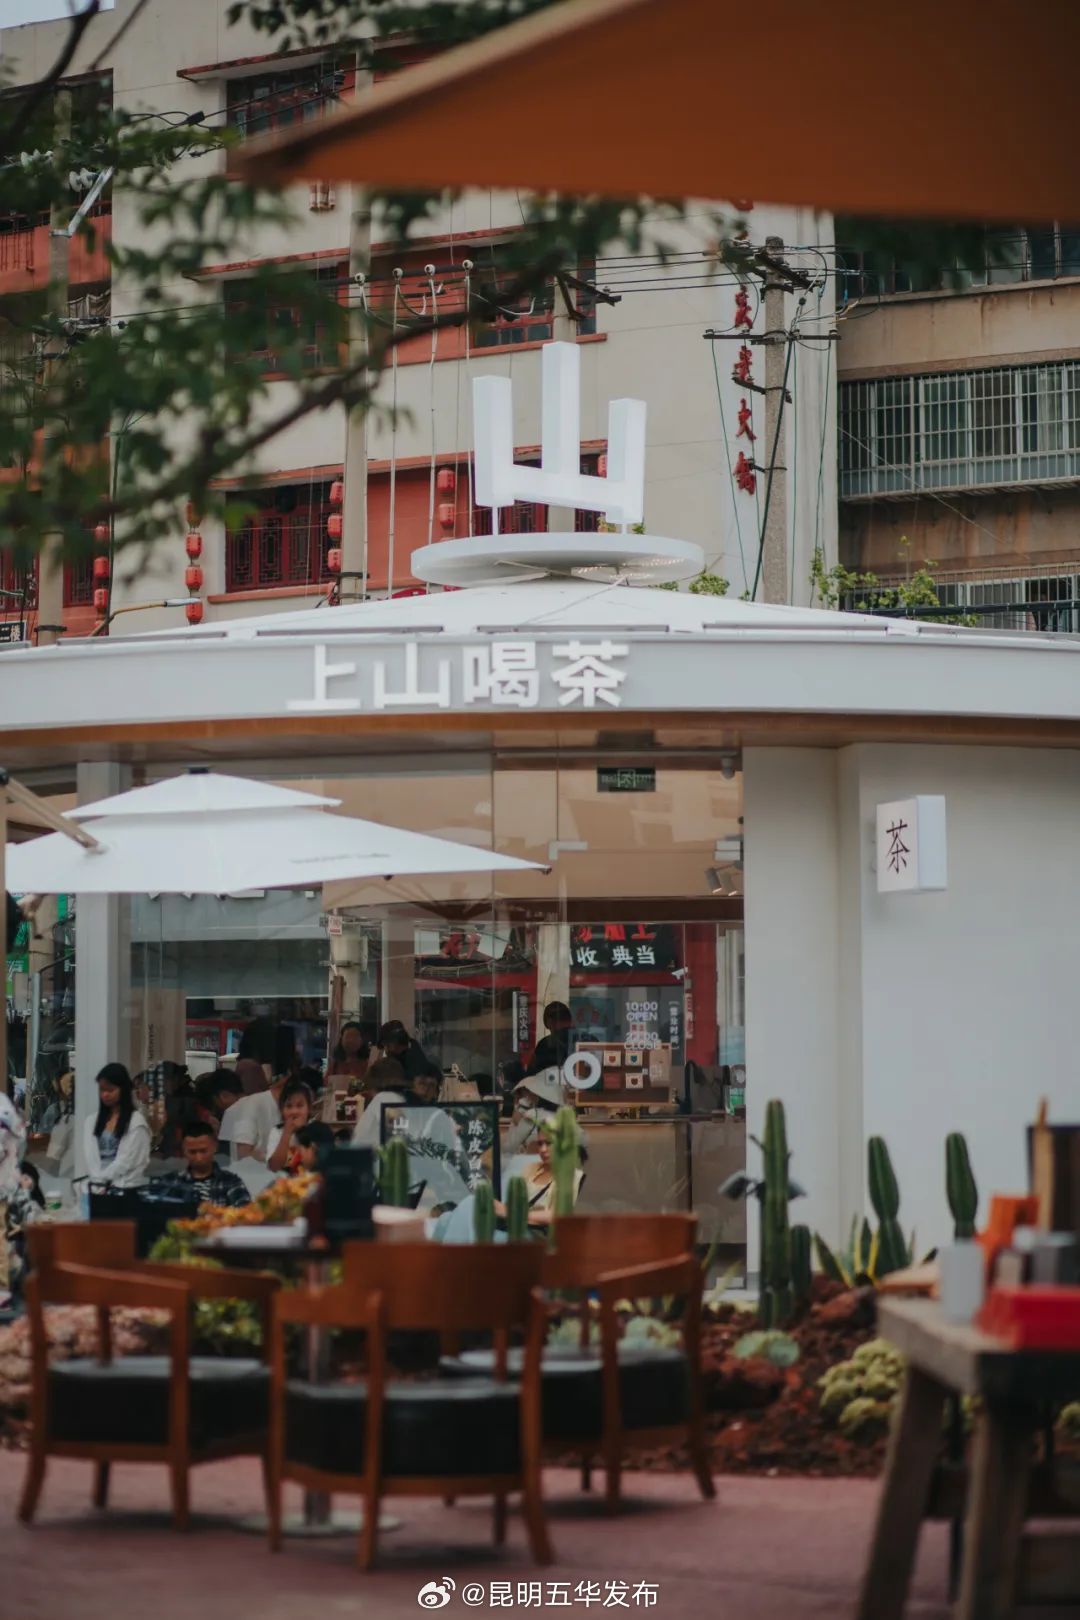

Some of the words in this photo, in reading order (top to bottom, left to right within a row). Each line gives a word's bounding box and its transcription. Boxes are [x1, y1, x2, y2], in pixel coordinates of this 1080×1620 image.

[286, 640, 630, 710] 上山喝茶
[886, 819, 910, 874] 茶
[611, 945, 656, 968] 典当
[625, 1002, 658, 1012] 10:00
[626, 1012, 658, 1021] OPEN
